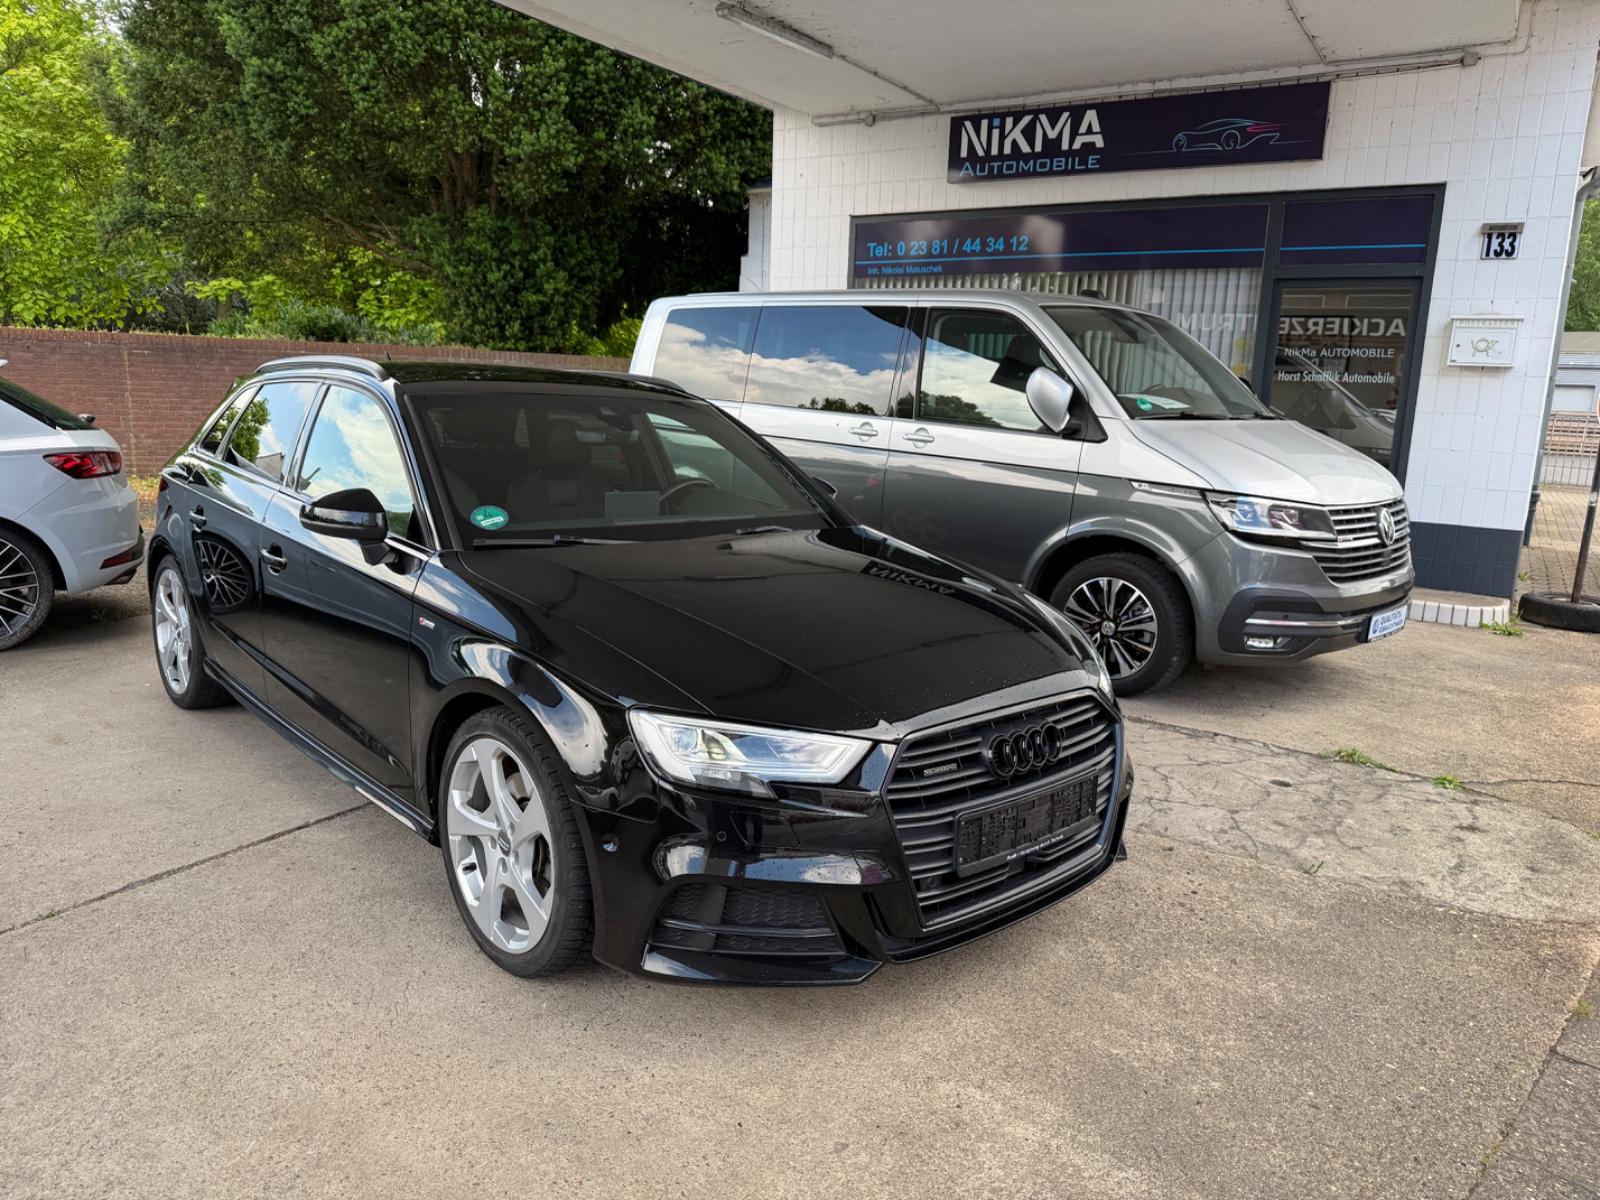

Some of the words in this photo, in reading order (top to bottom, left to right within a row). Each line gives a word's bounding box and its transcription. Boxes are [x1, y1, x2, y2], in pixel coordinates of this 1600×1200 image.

[960, 155, 1100, 177] AUTOMOBILE
[867, 242, 892, 257] Tel:
[897, 241, 905, 256] 0
[910, 240, 927, 255] 23
[932, 239, 948, 254] 81
[963, 238, 980, 253] 44
[986, 237, 1004, 252] 34
[1010, 236, 1029, 251] 12
[1485, 232, 1517, 257] 133
[1320, 348, 1395, 358] AUTOMOBILE
[1278, 370, 1300, 381] Horst
[1342, 372, 1395, 384] Automobile
